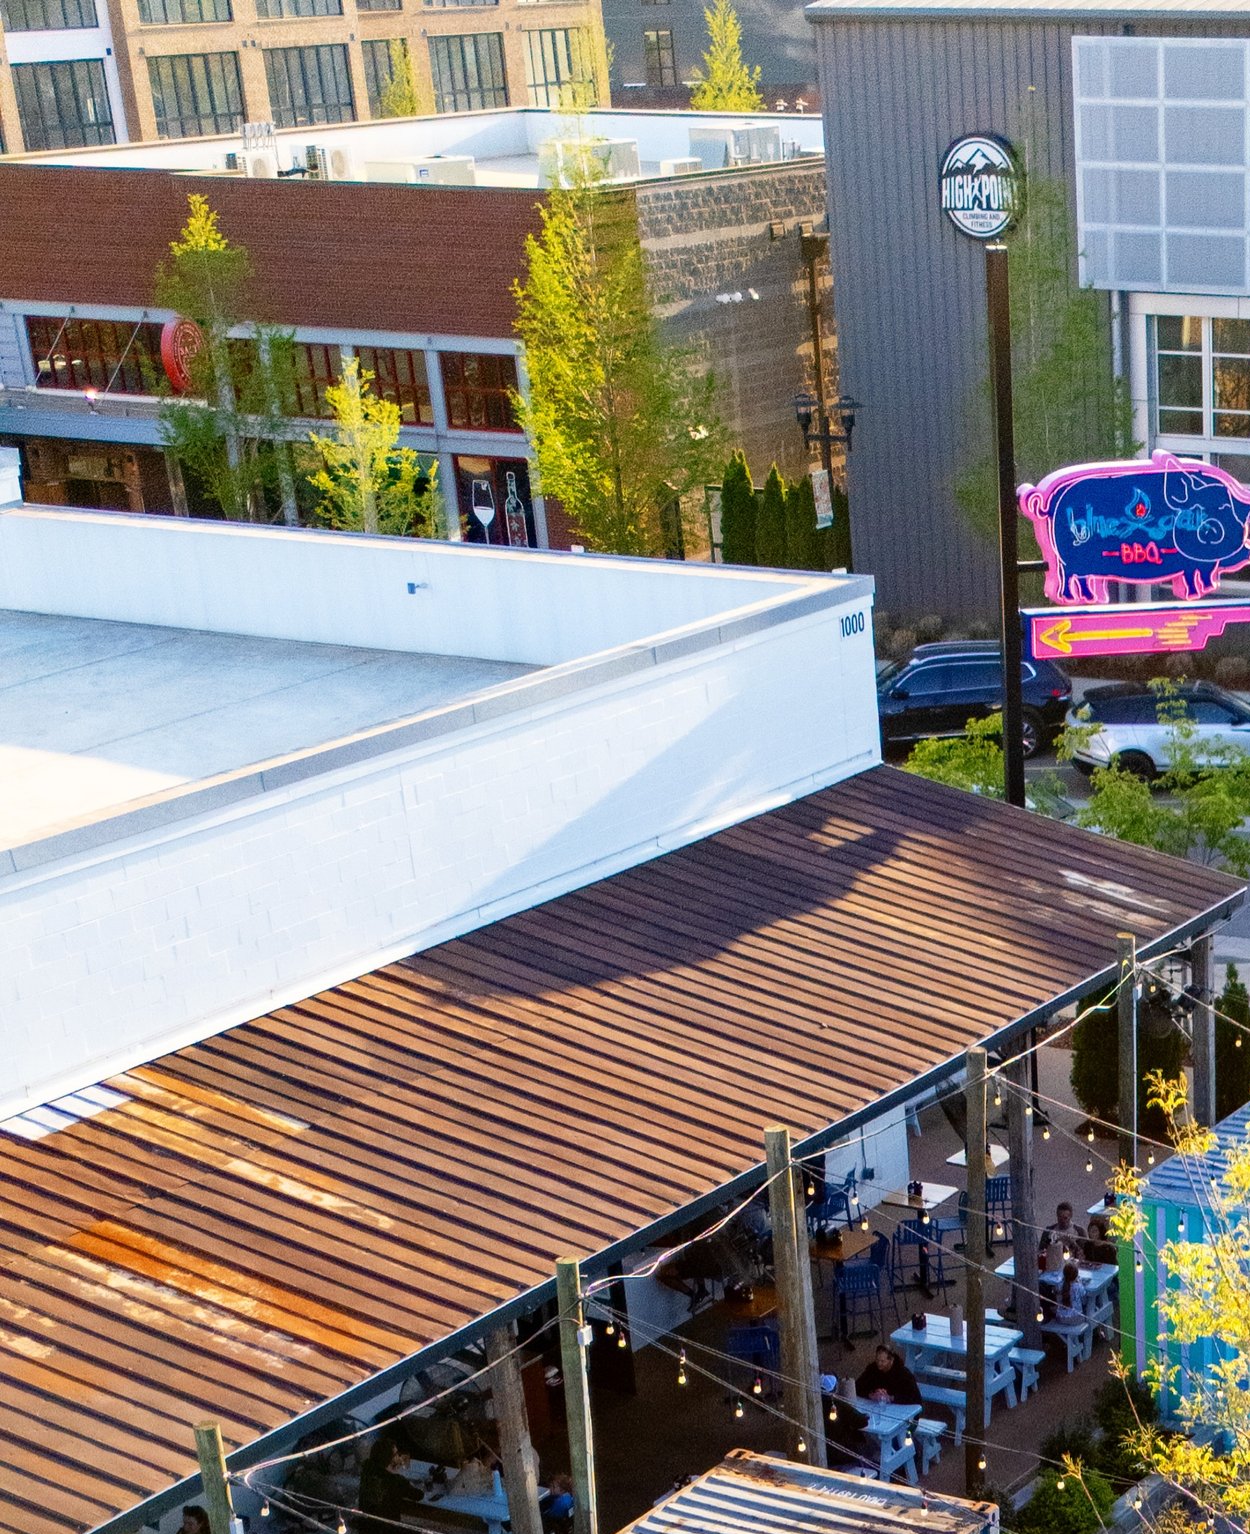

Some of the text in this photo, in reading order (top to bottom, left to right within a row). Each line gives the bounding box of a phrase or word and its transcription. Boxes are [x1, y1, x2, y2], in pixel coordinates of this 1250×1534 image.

[942, 174, 973, 209] HIGH
[1121, 541, 1163, 564] BBQ
[841, 611, 864, 637] 1000
